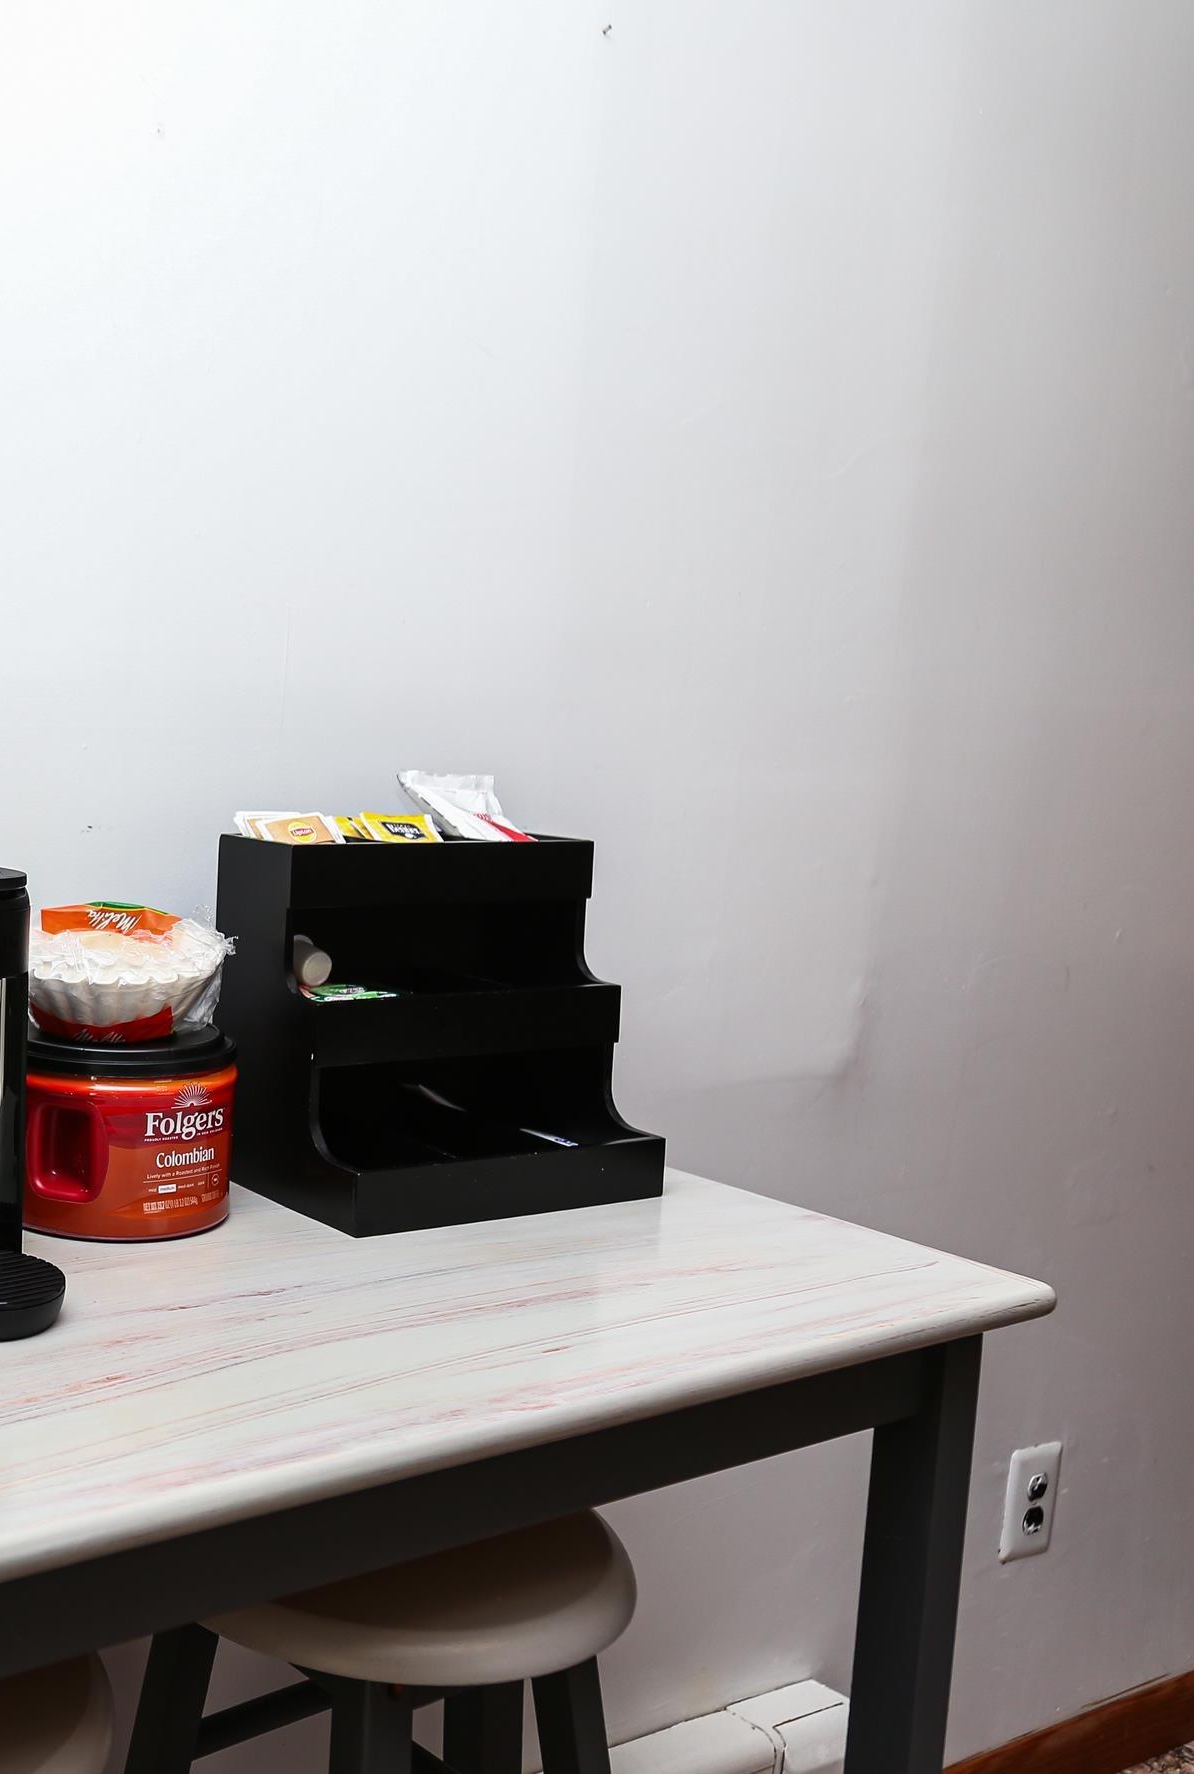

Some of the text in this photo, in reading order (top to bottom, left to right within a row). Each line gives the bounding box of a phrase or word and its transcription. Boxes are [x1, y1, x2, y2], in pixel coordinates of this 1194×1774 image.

[86, 910, 142, 931] Melitta
[144, 1108, 224, 1140] Folgers
[156, 1146, 214, 1168] Colombian
